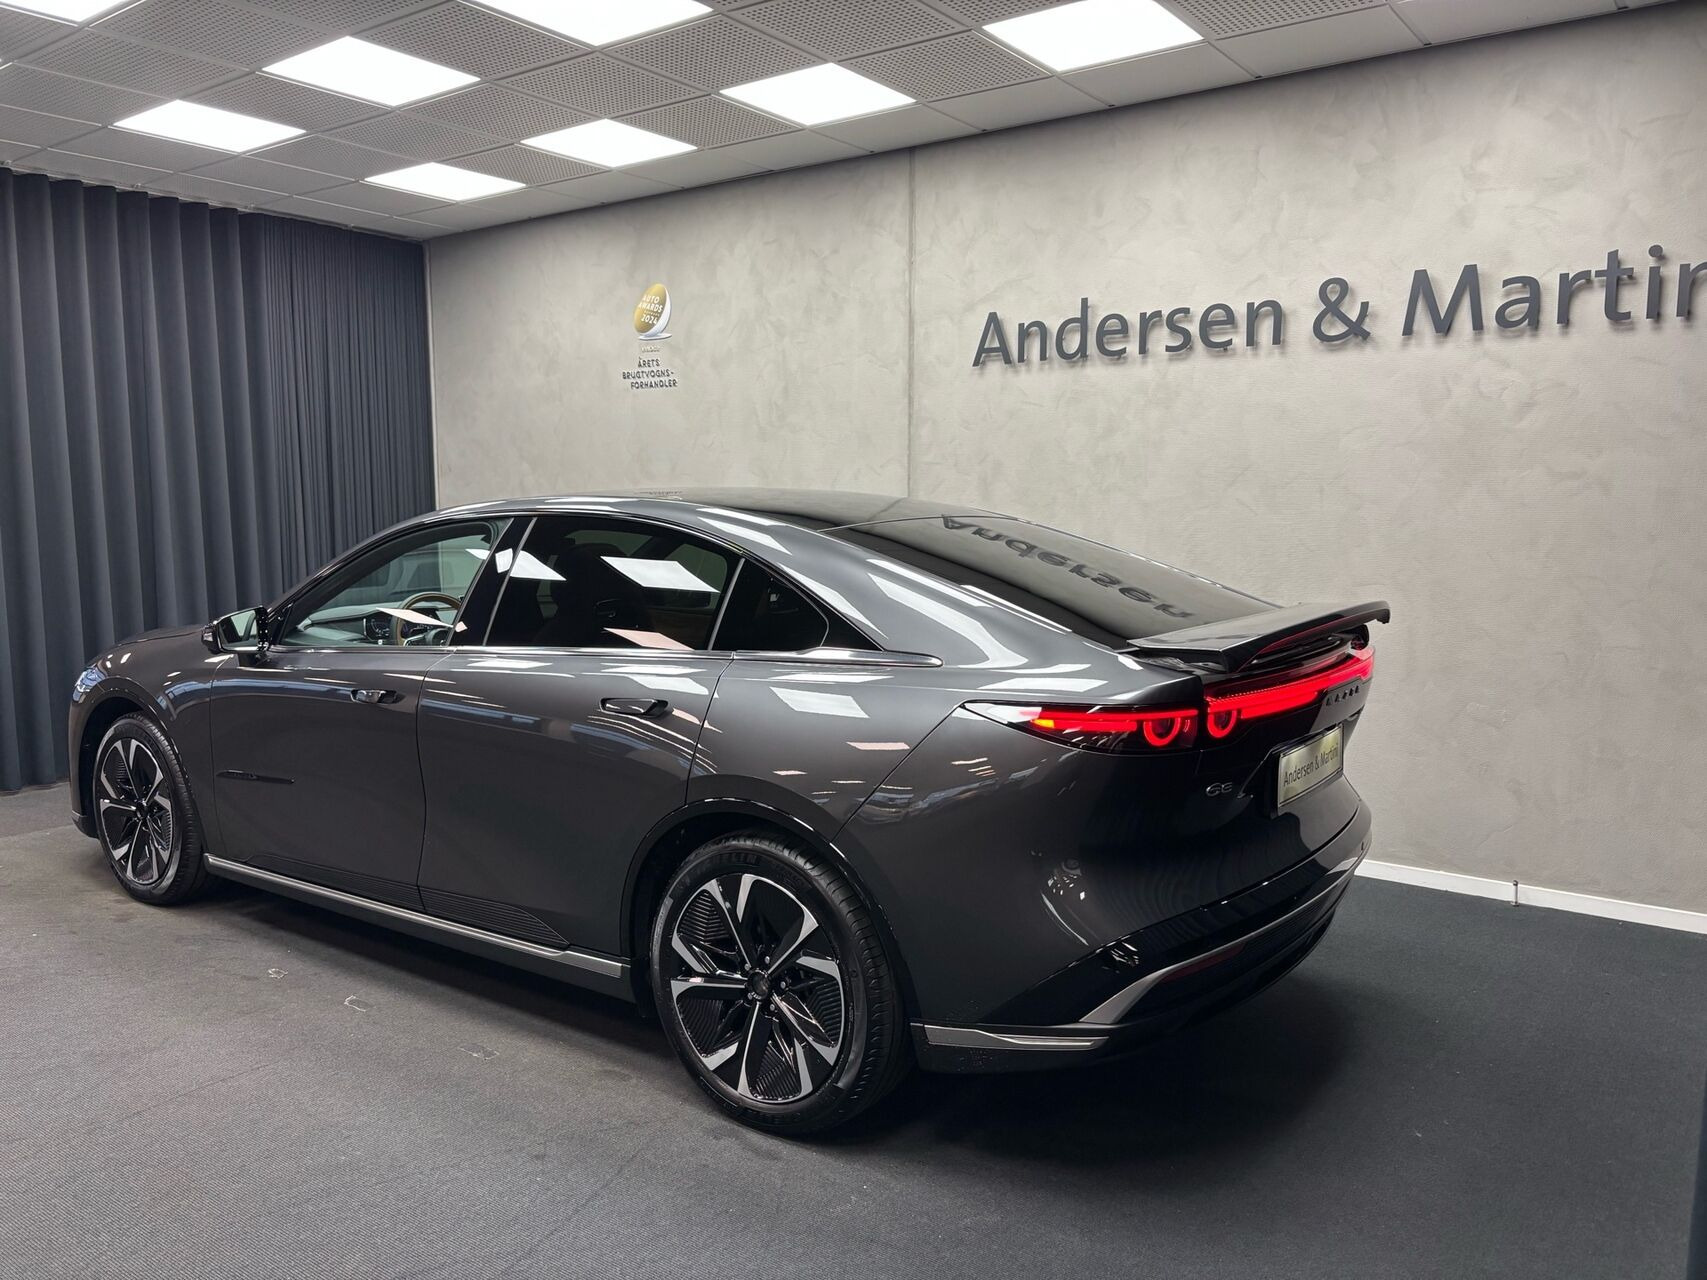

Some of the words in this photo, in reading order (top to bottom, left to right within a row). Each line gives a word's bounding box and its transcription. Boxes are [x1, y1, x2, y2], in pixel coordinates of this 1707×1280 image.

[642, 295, 660, 304] AUTO
[638, 302, 664, 313] AWARDS
[972, 297, 1284, 367] Andersen
[1312, 276, 1371, 342] &
[1402, 244, 1707, 336] Martin
[637, 357, 660, 368] ÅRETS
[622, 368, 674, 380] BRUGTVOGNS-
[630, 379, 678, 390] FORHANDLER
[1283, 760, 1314, 787] Andersen
